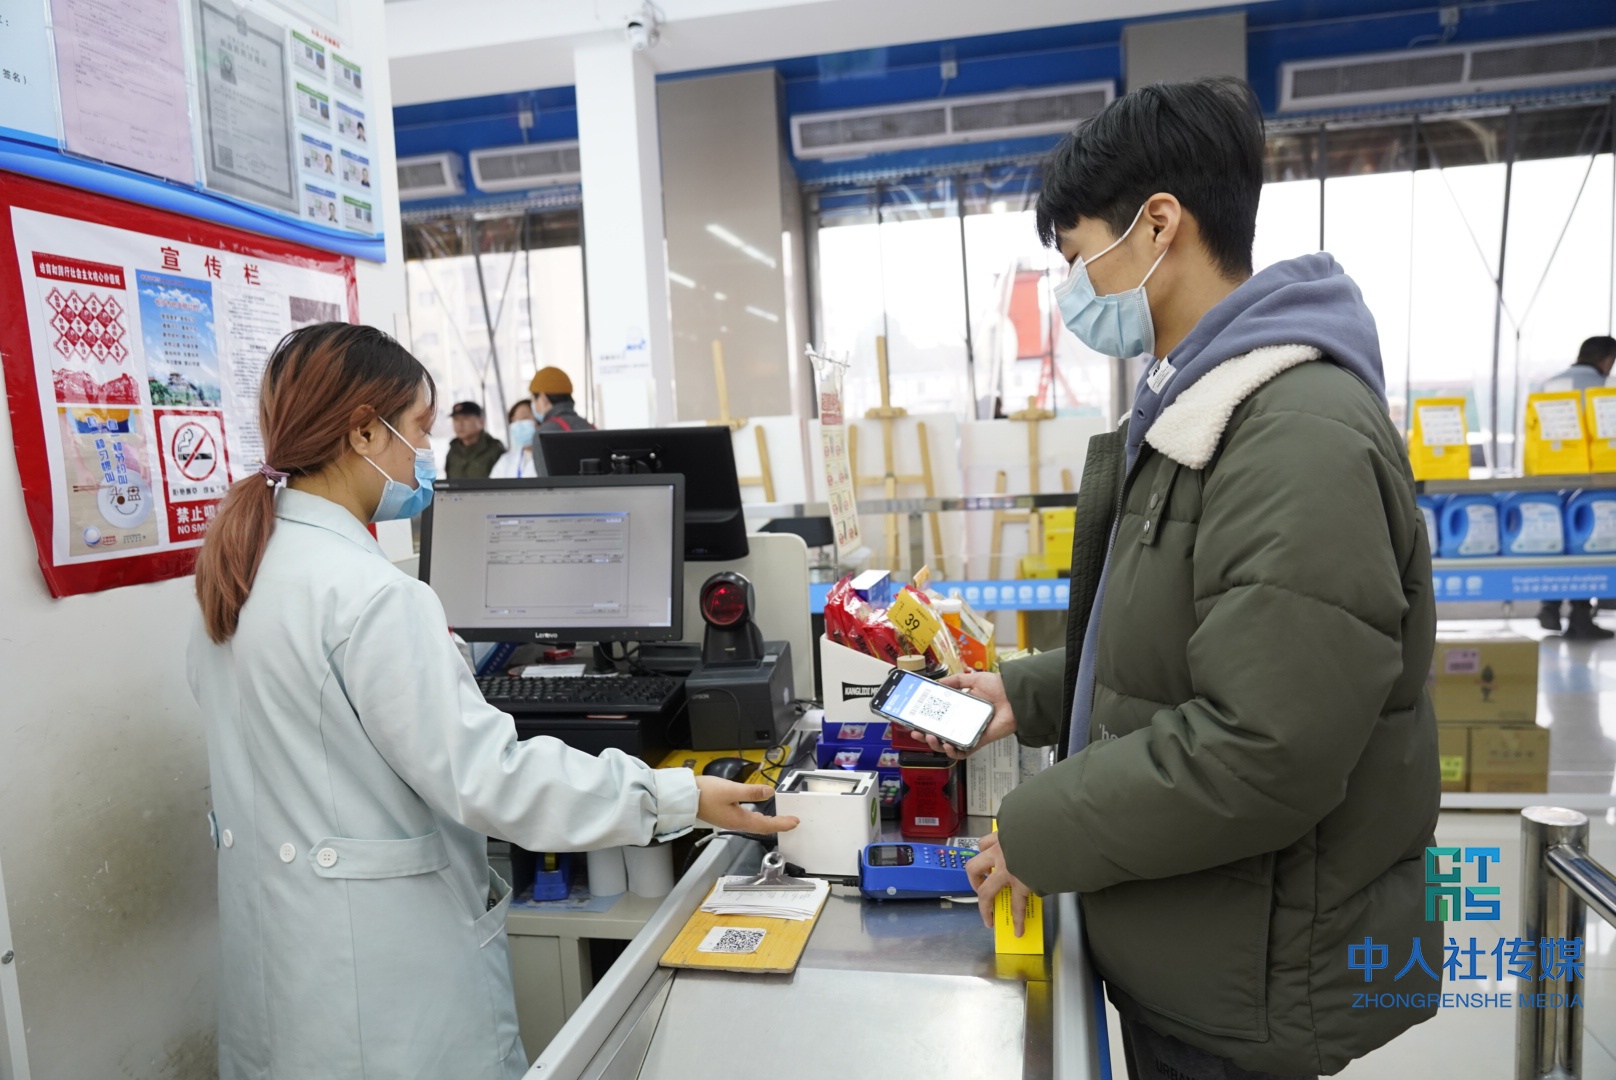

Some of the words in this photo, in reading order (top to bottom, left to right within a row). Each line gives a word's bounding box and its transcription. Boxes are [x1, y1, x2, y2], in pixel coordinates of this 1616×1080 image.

[39, 262, 121, 286] 培育和践行社会主义核心价值观
[160, 246, 262, 286] 宣传栏
[110, 486, 142, 504] 光盘
[176, 504, 223, 524] 禁止吸
[177, 524, 191, 535] NO
[904, 613, 921, 631] 39
